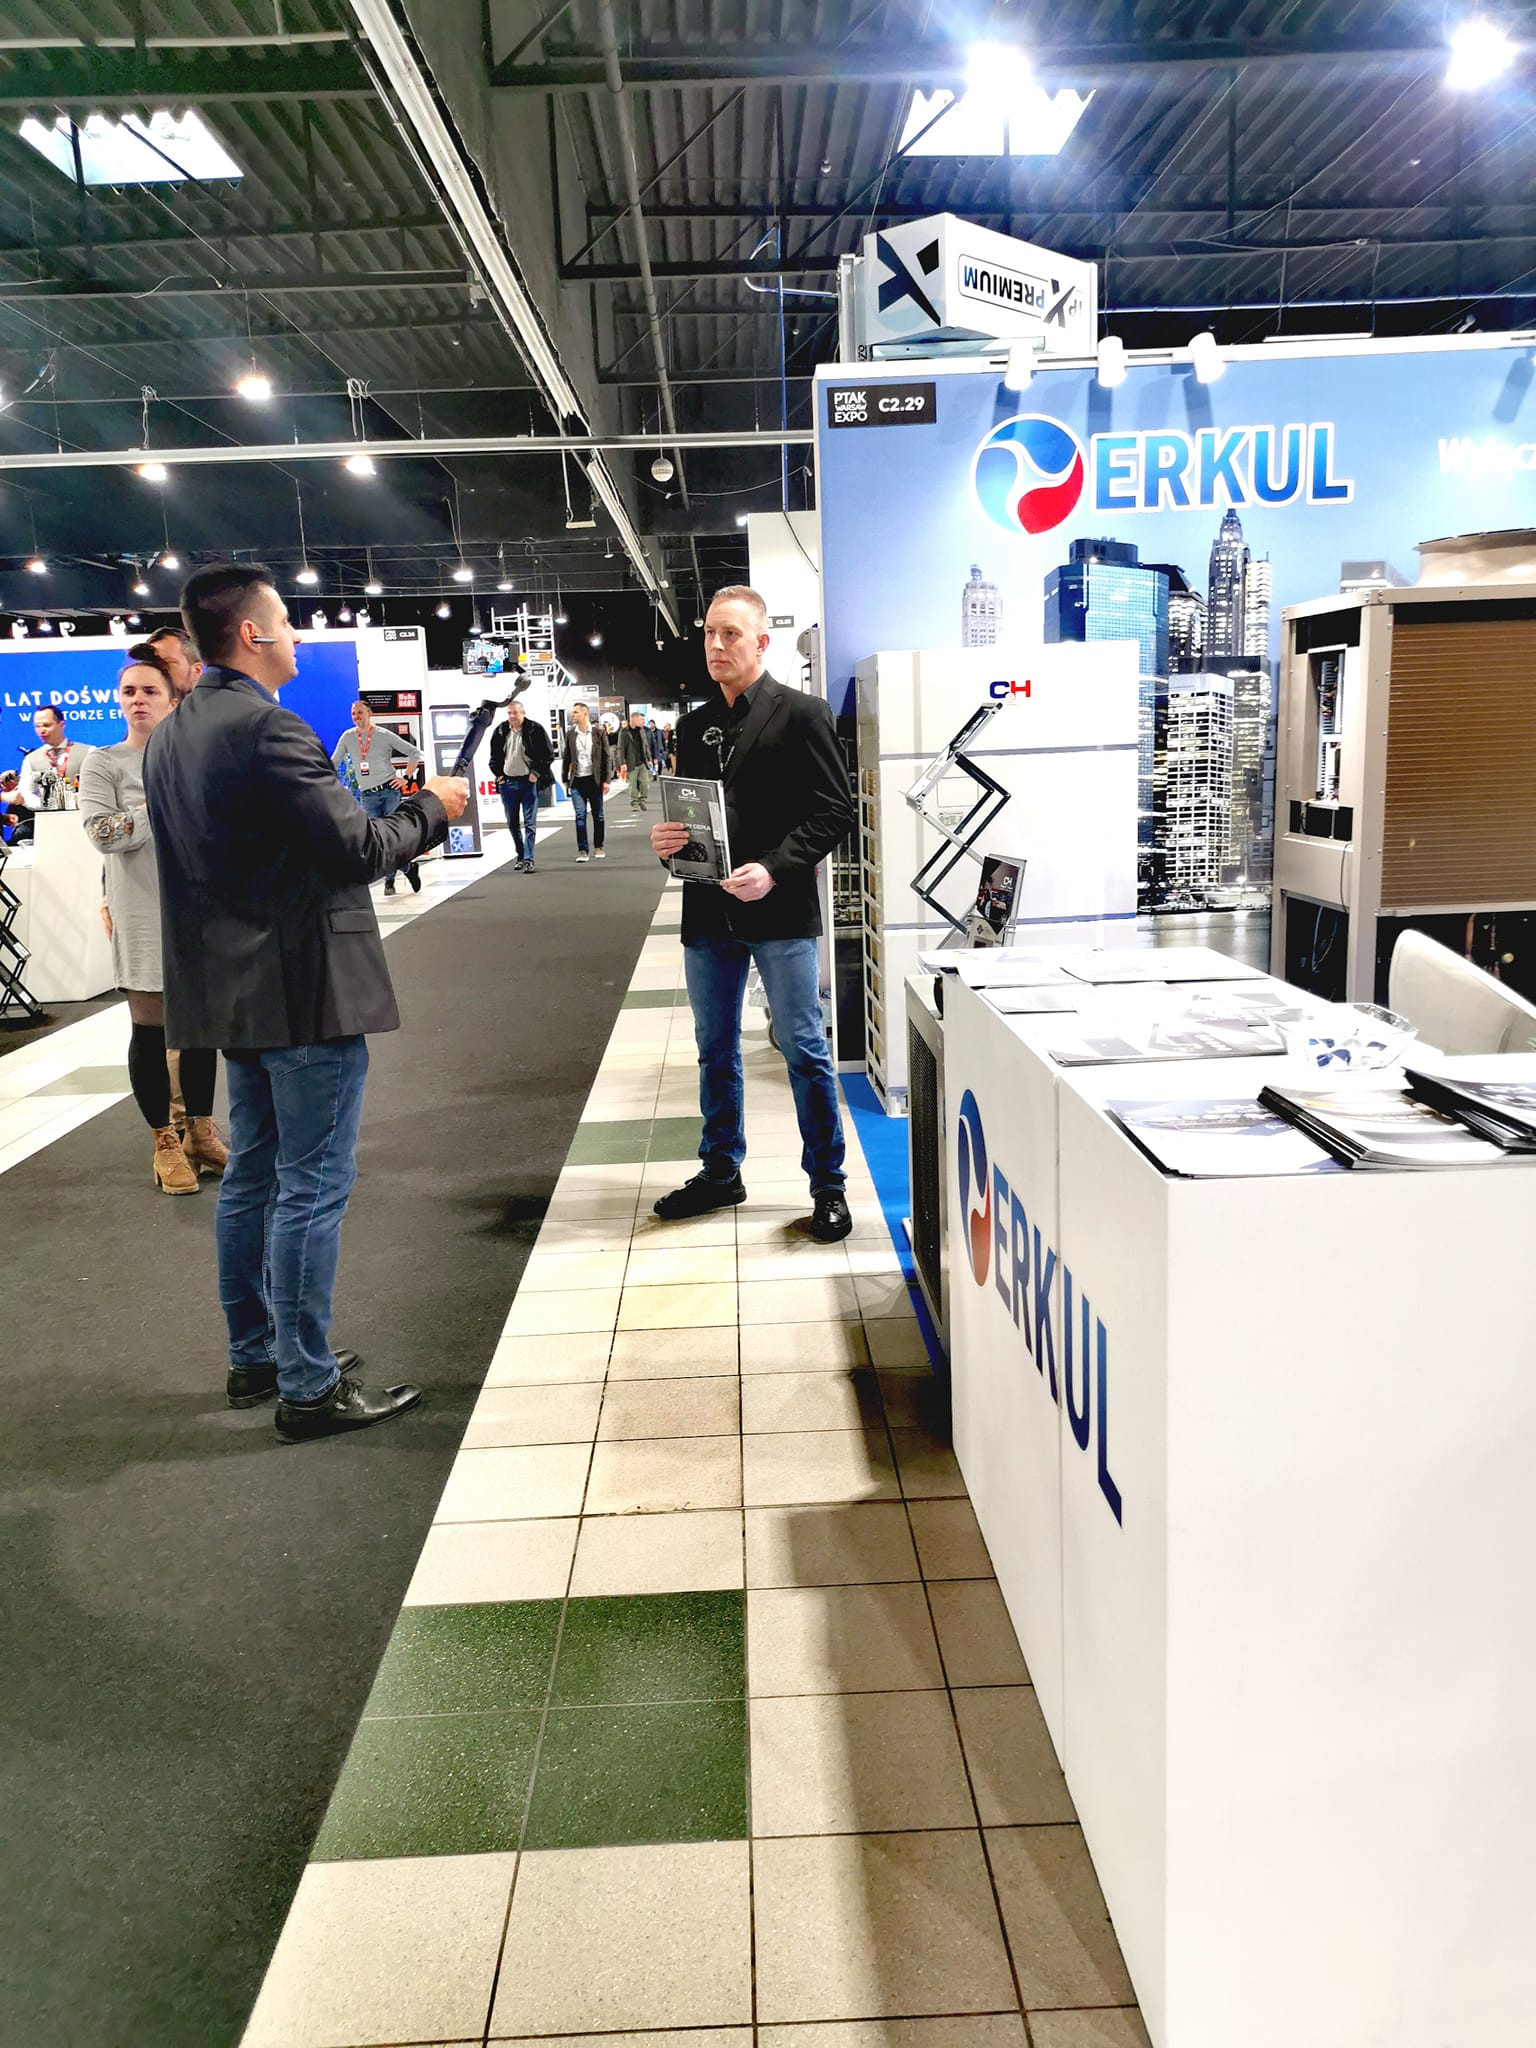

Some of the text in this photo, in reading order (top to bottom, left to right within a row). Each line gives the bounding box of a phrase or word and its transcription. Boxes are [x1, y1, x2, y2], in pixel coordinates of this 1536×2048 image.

[963, 265, 1045, 309] PREMIUM
[834, 391, 866, 404] PTAK
[878, 396, 925, 412] C2.29
[835, 403, 867, 411] WARSAW
[834, 411, 868, 423] EXPO
[1093, 426, 1350, 512] ERKUL
[989, 680, 1031, 699] CH
[4, 691, 43, 707] LAT
[19, 712, 32, 722] W
[681, 788, 697, 797] CH
[993, 1161, 1123, 1529] ERKUL
